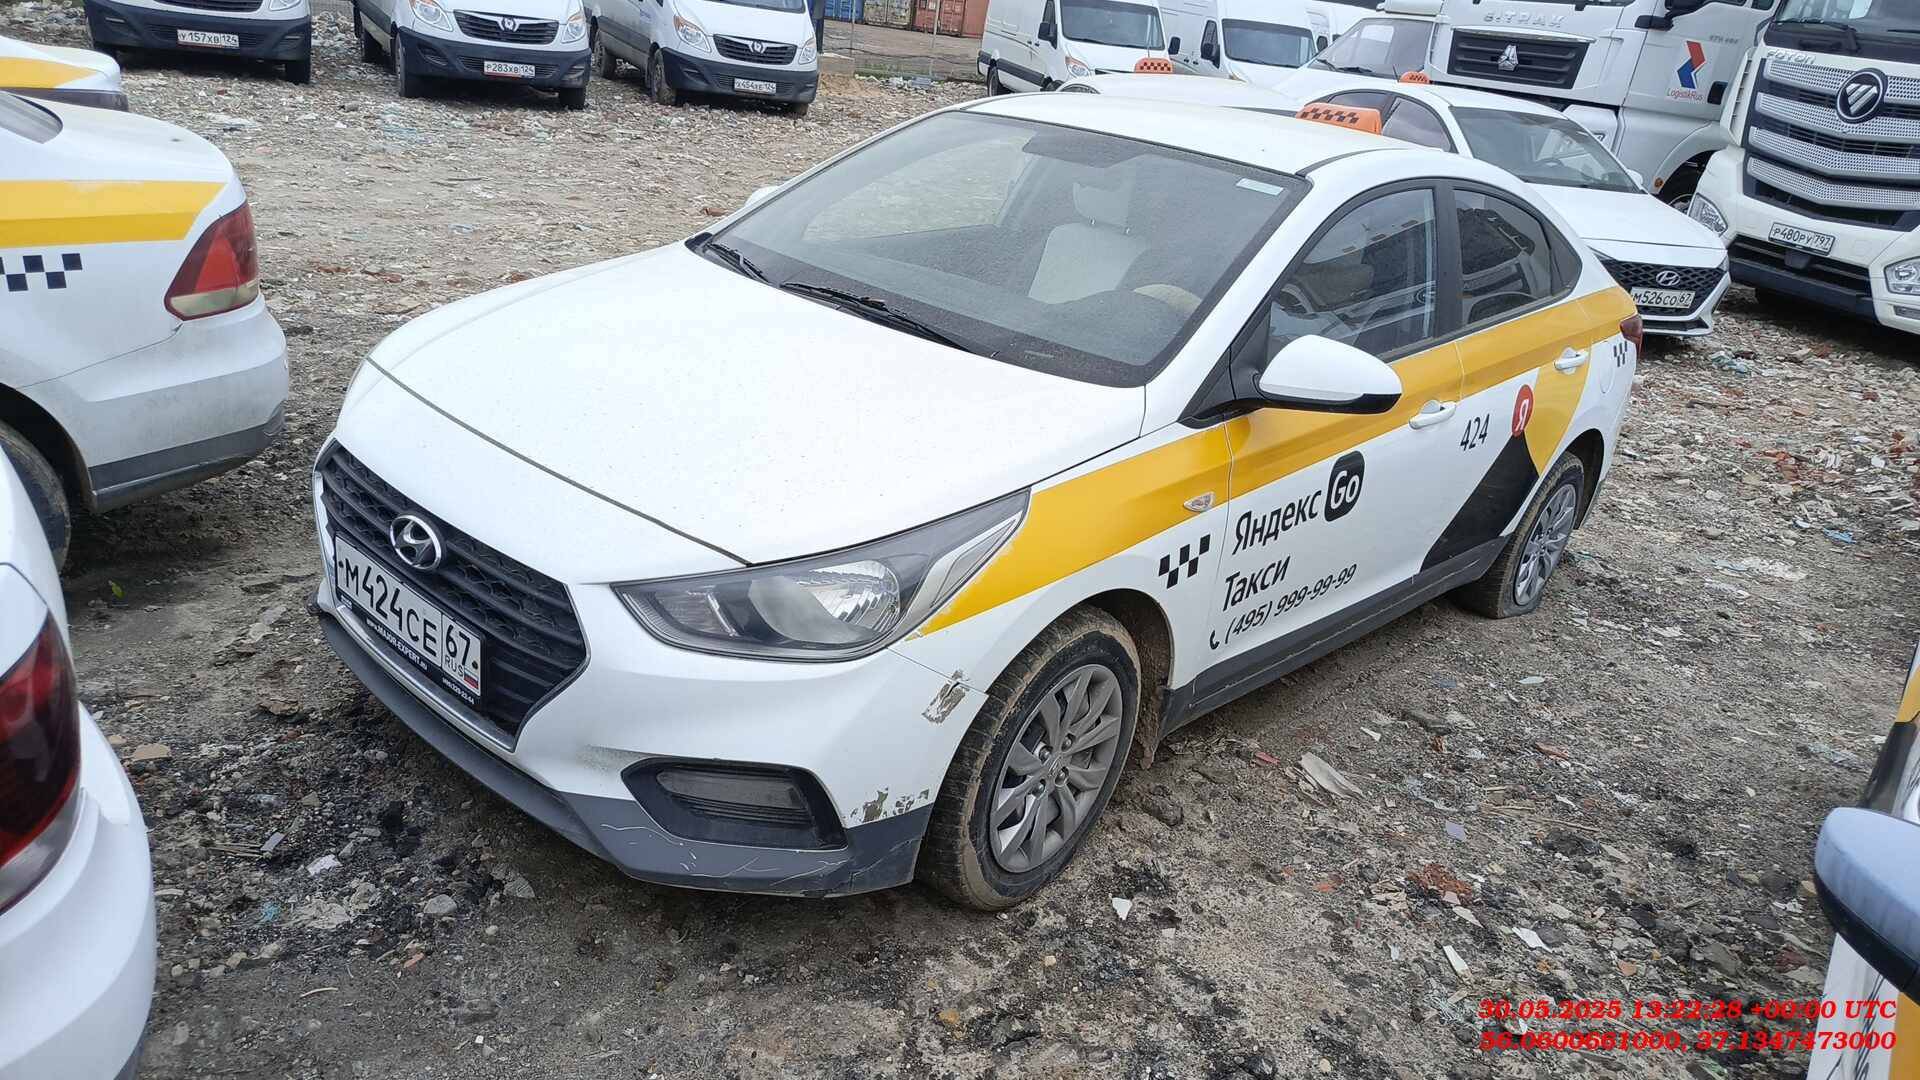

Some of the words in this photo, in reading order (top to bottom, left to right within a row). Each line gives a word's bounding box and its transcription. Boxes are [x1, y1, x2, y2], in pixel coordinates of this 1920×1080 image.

[1680, 293, 1691, 303] 67
[1460, 413, 1490, 452] 424
[1515, 398, 1529, 432] Я
[1232, 490, 1322, 555] Яндекс
[1330, 469, 1361, 510] Go
[1223, 555, 1291, 612] Такси
[1225, 600, 1273, 645] (495)
[1274, 563, 1357, 618] 999-99-99
[345, 557, 437, 658] М424СЕ
[445, 624, 471, 666] 67
[444, 653, 464, 679] RUS
